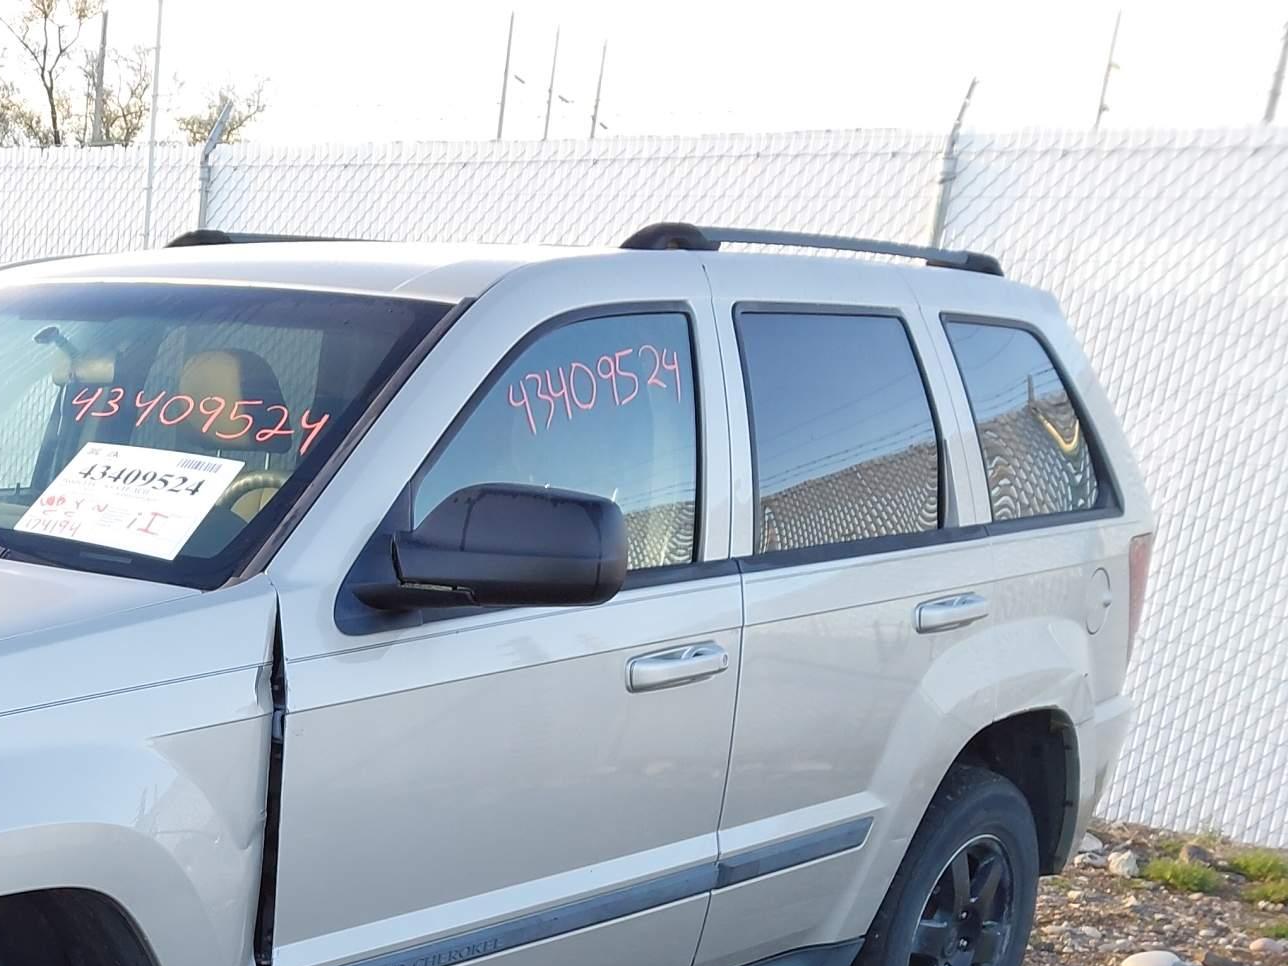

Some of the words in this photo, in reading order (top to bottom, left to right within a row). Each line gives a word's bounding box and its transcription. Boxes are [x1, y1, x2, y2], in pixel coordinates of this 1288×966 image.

[72, 387, 330, 456] 43409524
[508, 345, 681, 435] 43409524
[78, 463, 206, 496] 43409524
